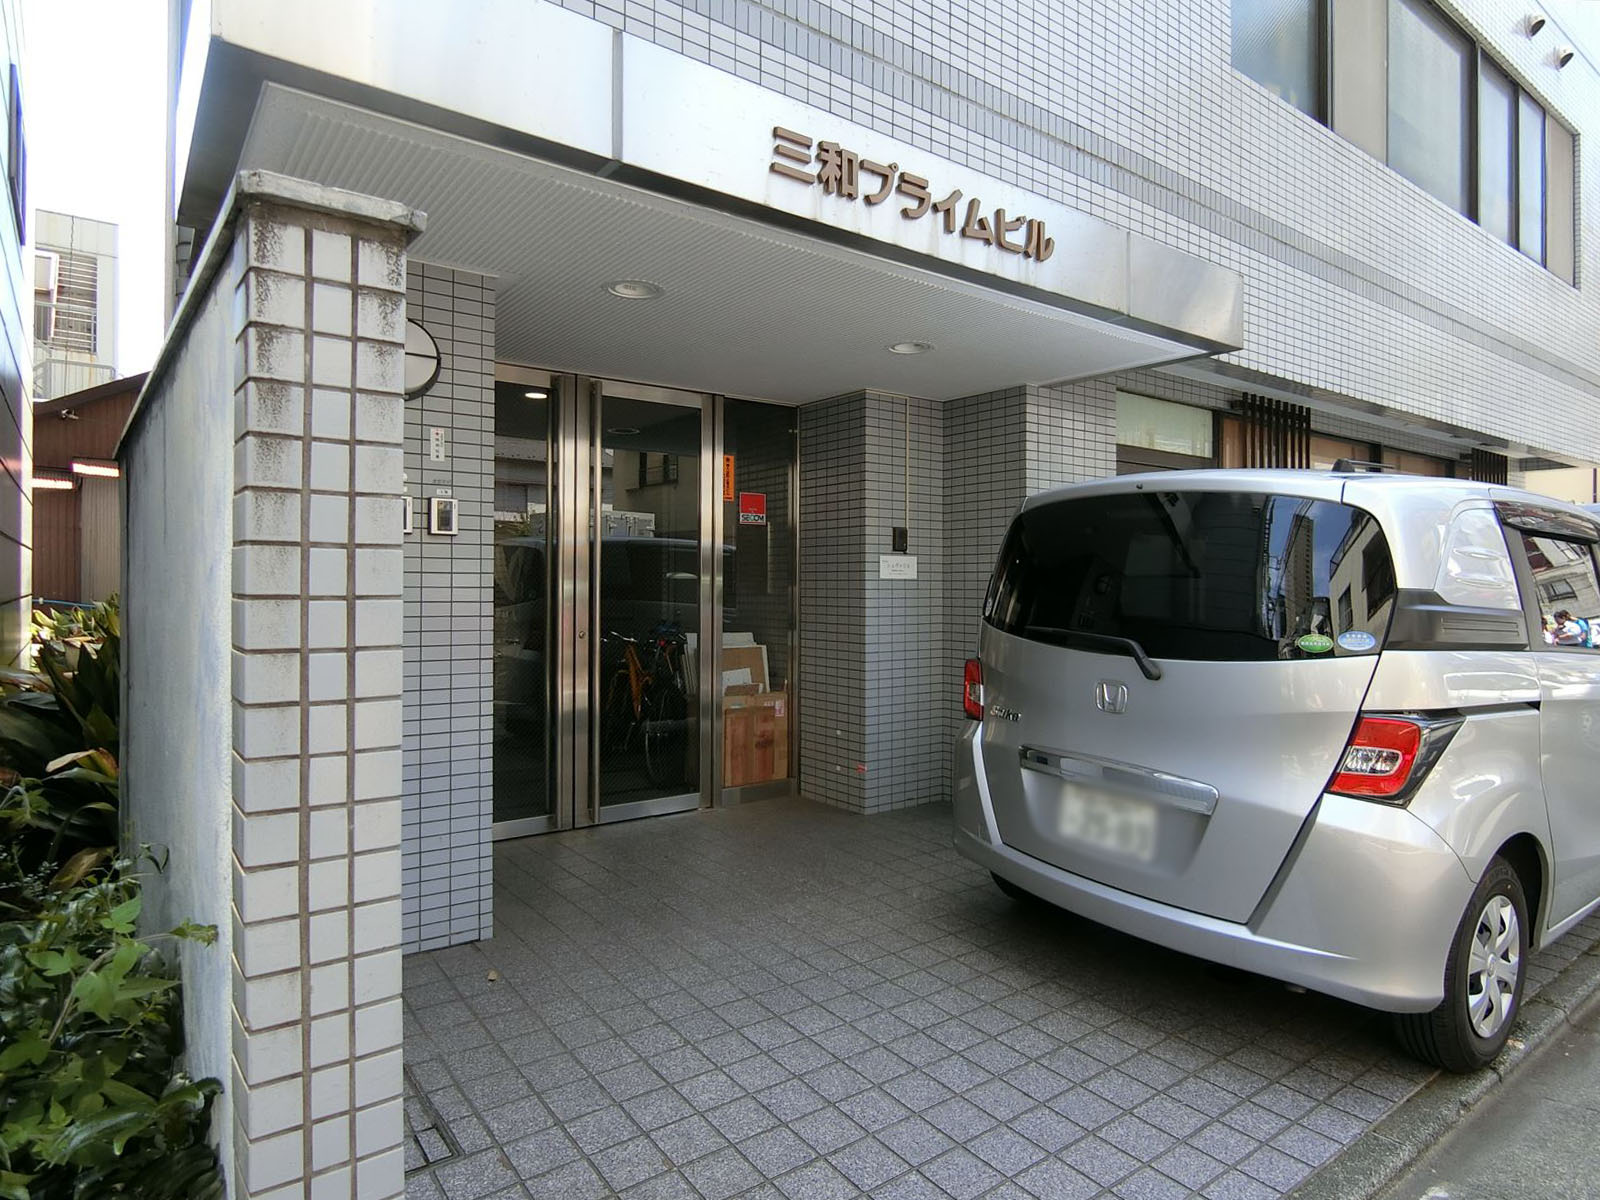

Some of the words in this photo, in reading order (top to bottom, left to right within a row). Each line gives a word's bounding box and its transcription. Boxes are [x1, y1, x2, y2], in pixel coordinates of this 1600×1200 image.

[770, 125, 1055, 263] 三和プライムビル
